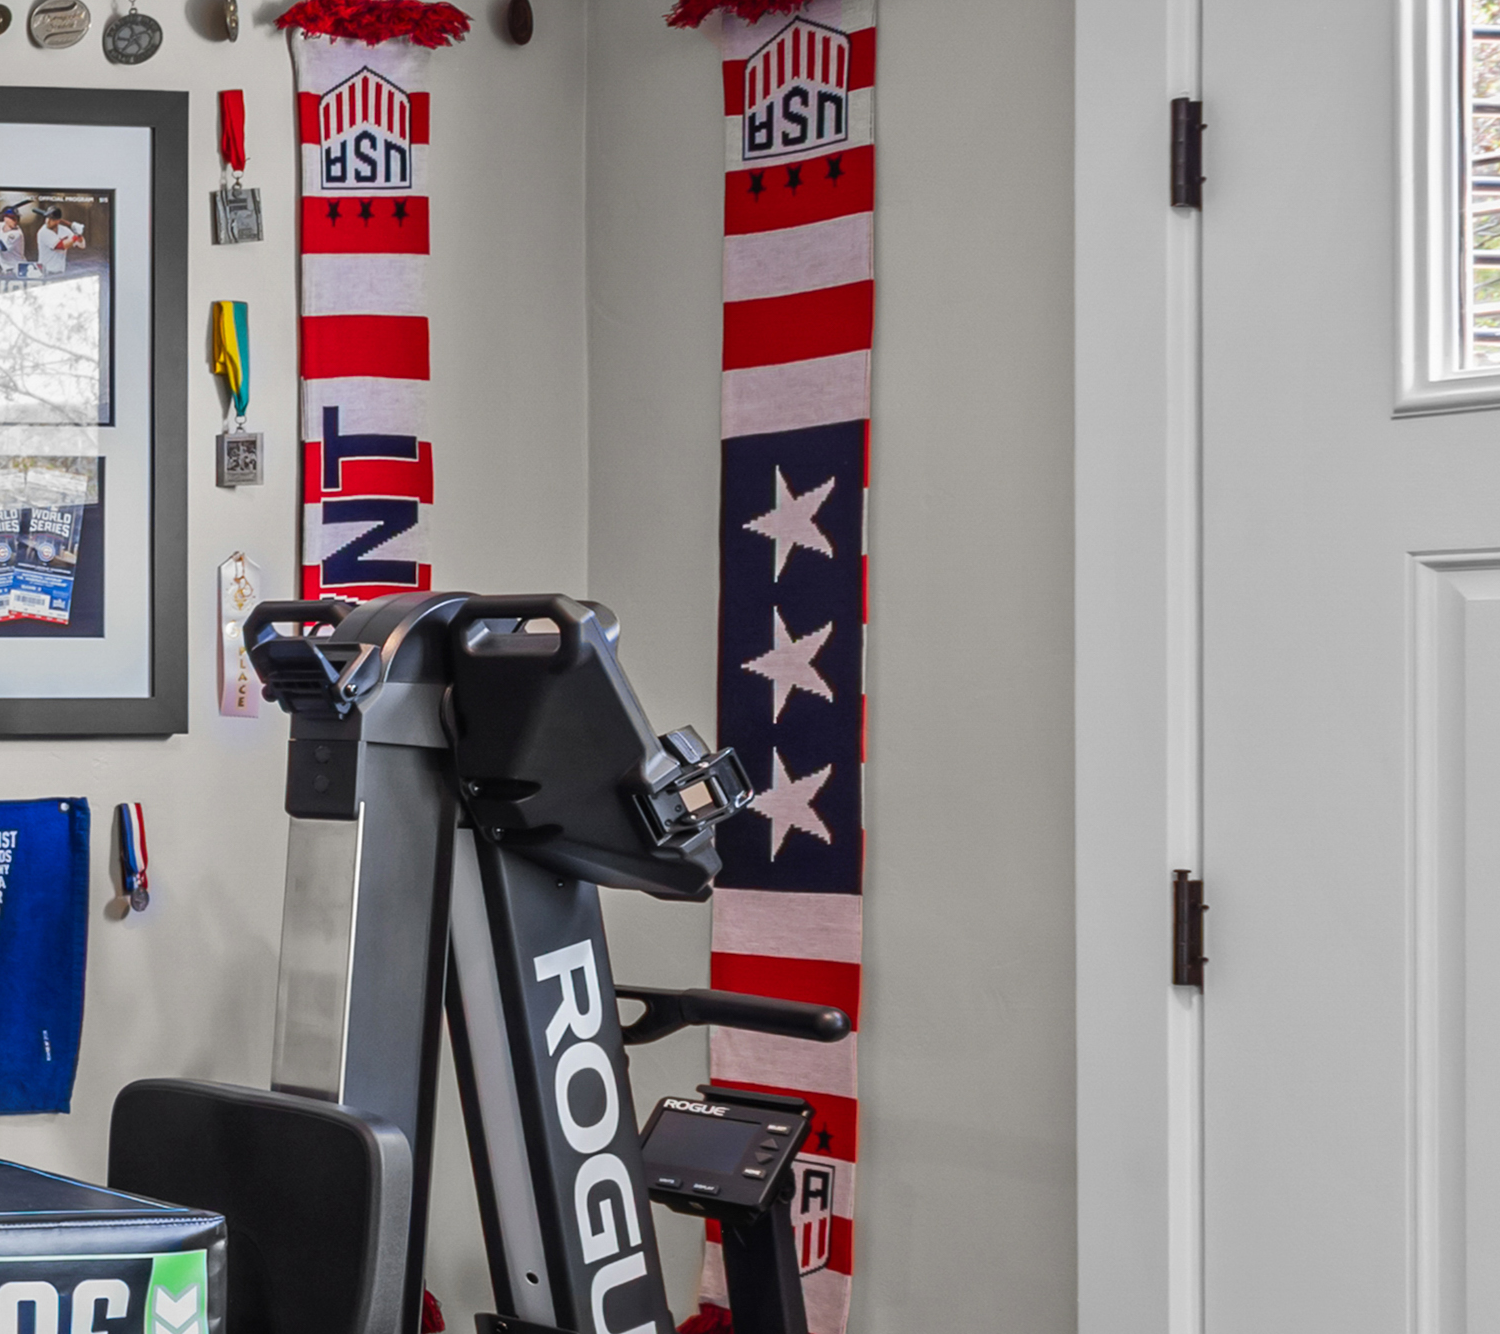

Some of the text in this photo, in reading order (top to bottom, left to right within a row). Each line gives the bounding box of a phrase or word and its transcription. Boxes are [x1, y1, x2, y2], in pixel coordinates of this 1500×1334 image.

[747, 85, 844, 153] USA
[325, 129, 408, 184] USA
[32, 508, 72, 524] WORLD
[29, 519, 71, 538] SERIES
[663, 1098, 730, 1117] ROGUE
